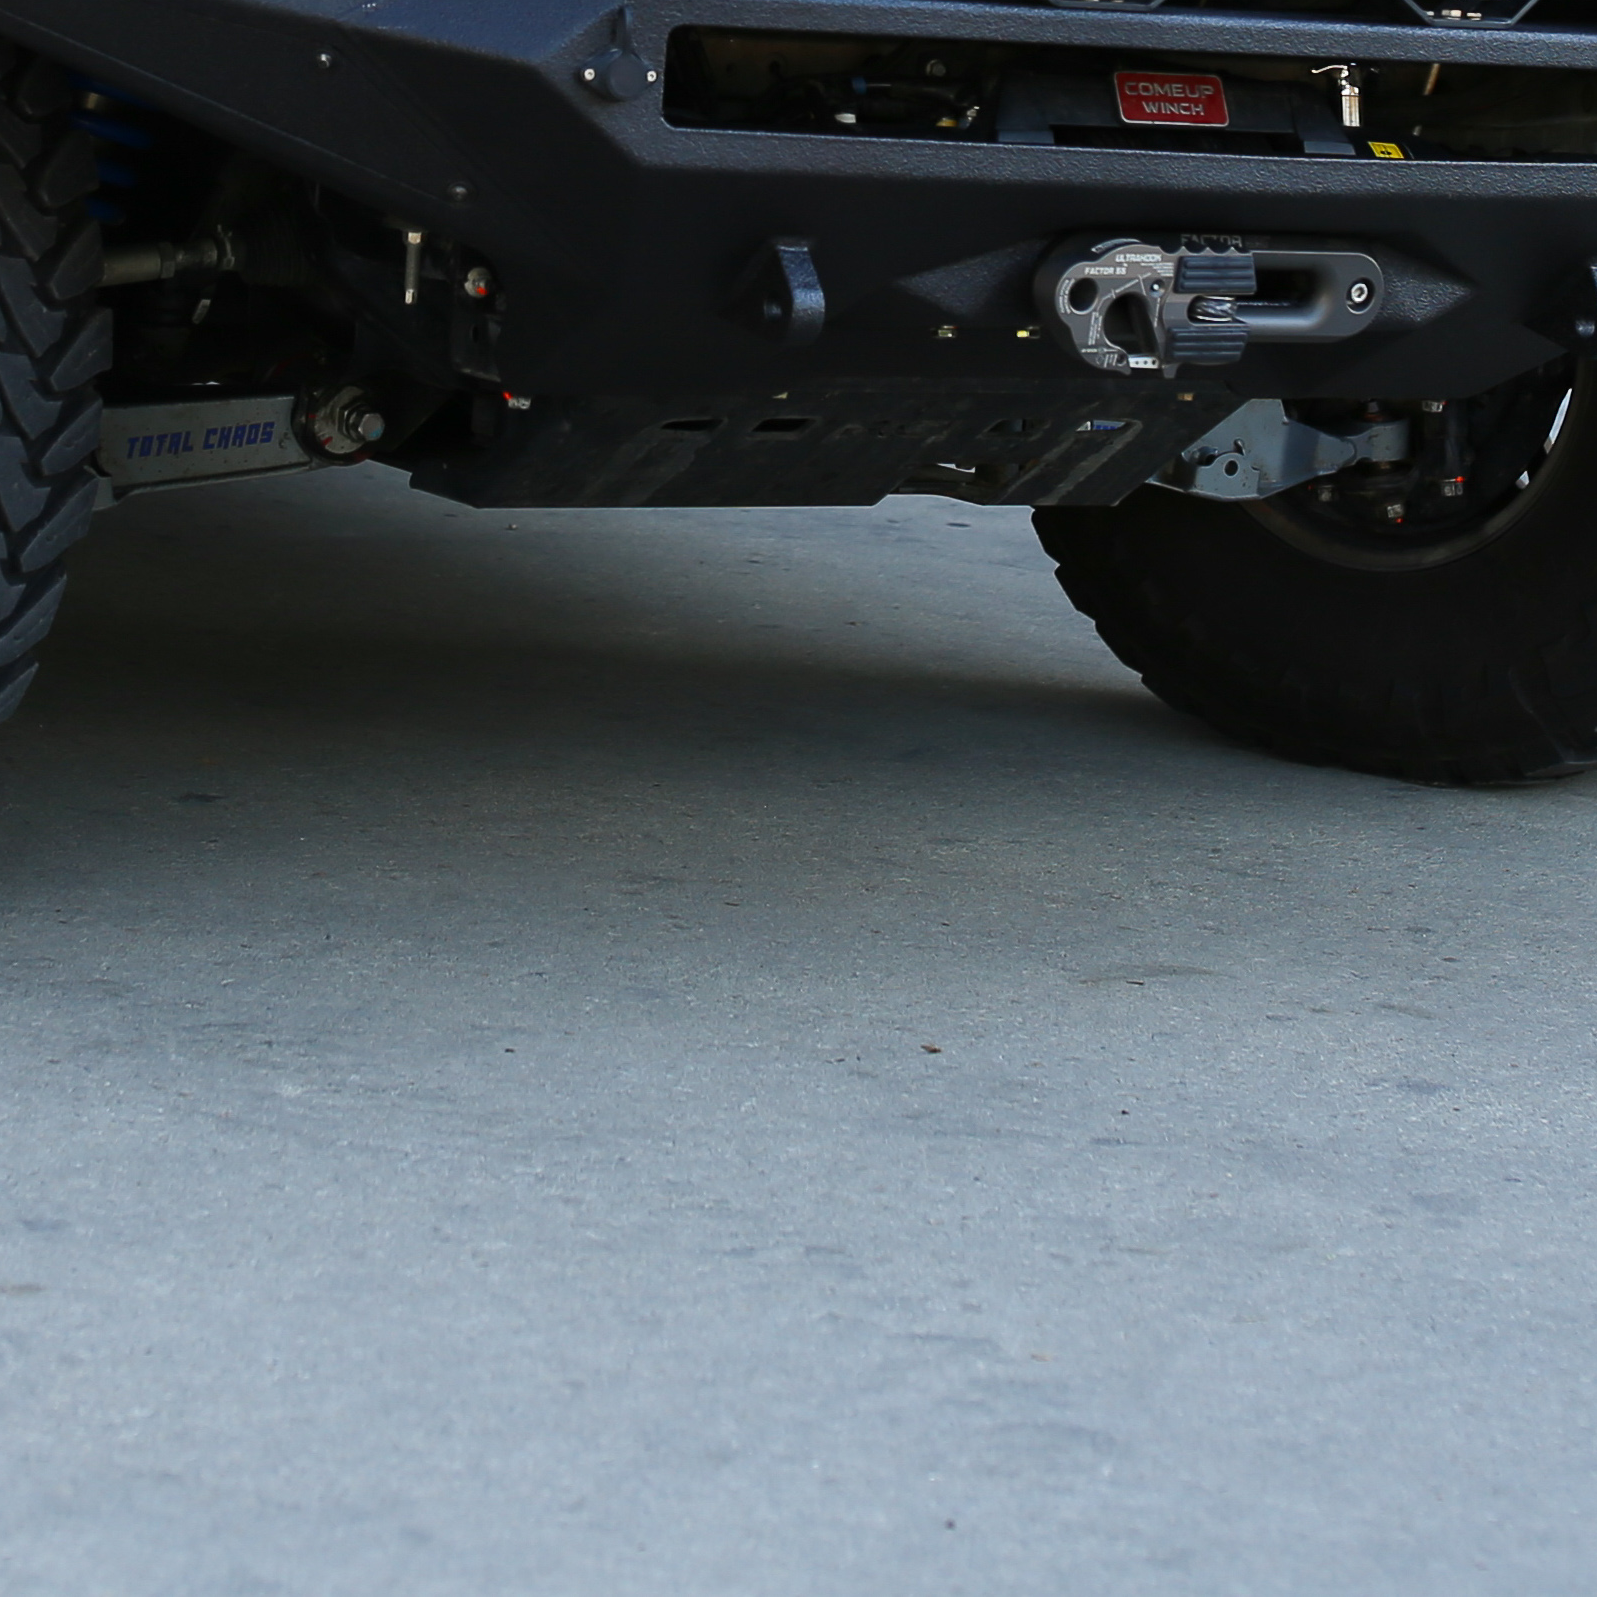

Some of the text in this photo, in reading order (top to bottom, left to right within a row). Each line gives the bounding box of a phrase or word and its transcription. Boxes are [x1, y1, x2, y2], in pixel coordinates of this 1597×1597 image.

[1124, 82, 1215, 99] COMEUP
[1142, 101, 1205, 116] WINCH
[1084, 267, 1114, 275] FACTOR
[127, 421, 275, 459] TOTAL CHAOS
